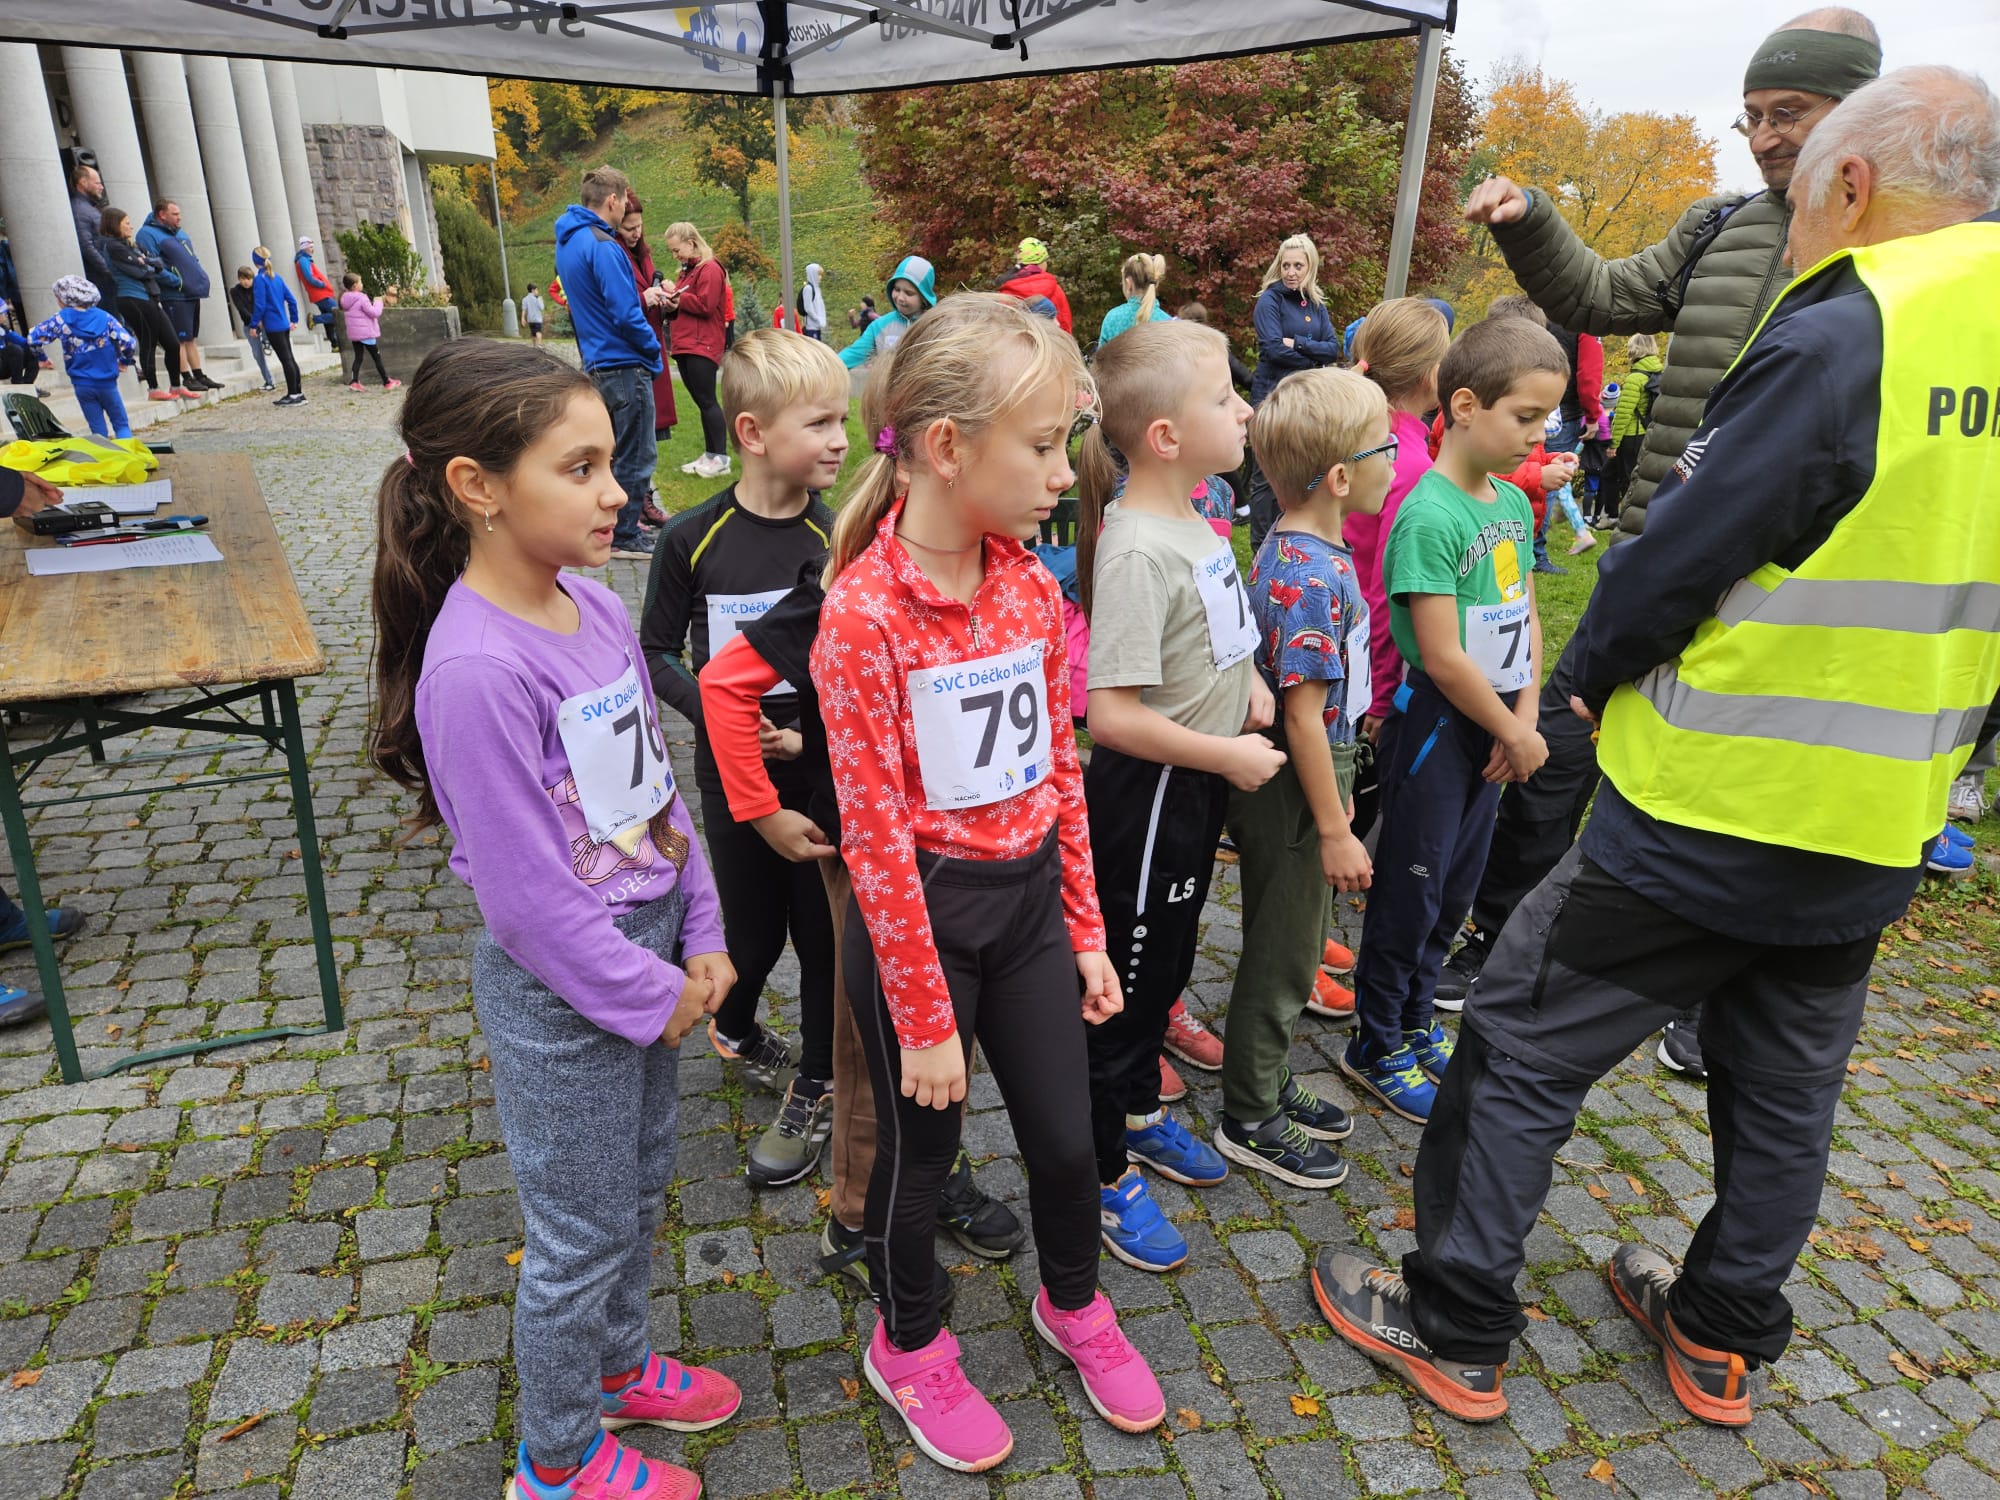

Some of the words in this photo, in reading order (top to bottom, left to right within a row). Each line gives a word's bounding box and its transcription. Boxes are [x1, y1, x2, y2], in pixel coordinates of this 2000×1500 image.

[933, 672, 965, 694] SVČ
[968, 667, 1011, 687] Déčko
[581, 696, 614, 722] SVČ
[959, 681, 1039, 769] 79
[1167, 876, 1196, 903] LS
[1371, 1323, 1431, 1352] KEEN
